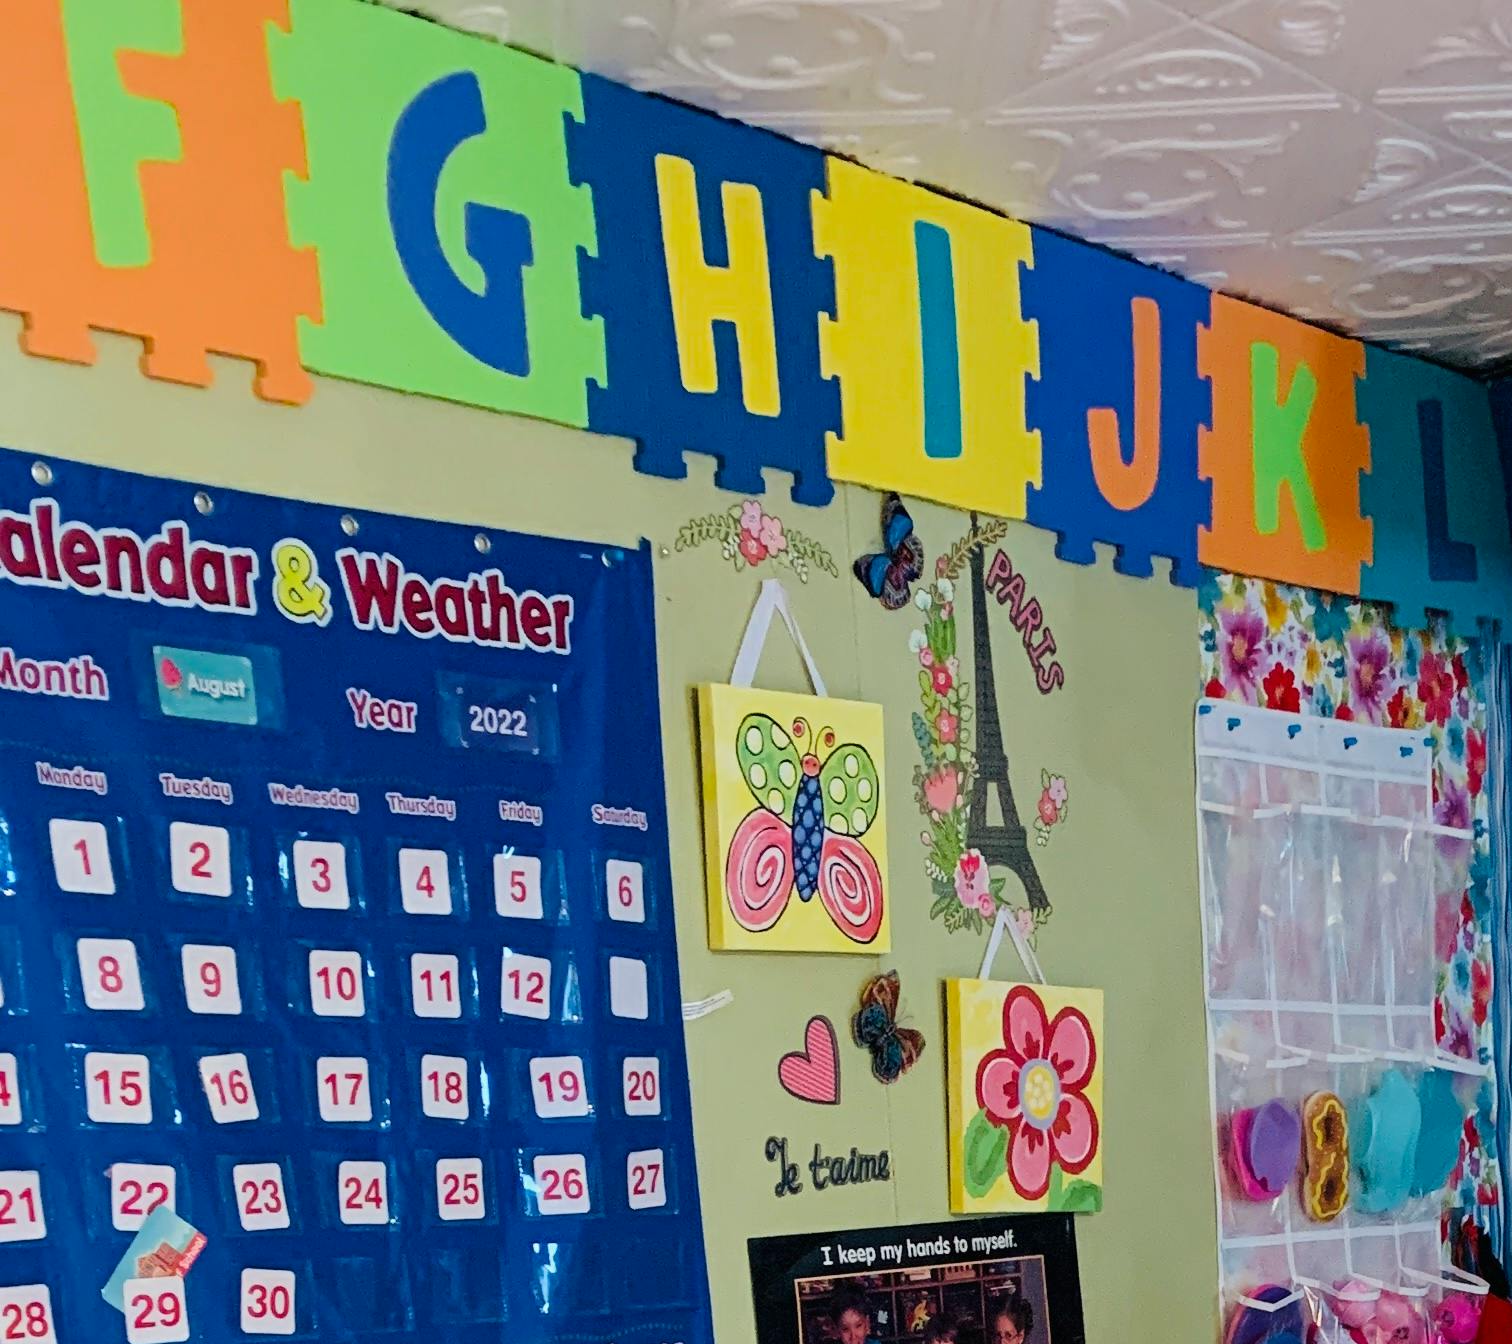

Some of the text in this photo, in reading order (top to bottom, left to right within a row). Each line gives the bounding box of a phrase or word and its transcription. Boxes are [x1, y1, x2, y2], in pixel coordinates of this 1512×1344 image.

[62, 0, 184, 268] F
[386, 70, 533, 377] G
[655, 154, 781, 416] H
[914, 219, 962, 458] I
[1088, 297, 1161, 511] J
[1250, 341, 1326, 552] K
[1417, 399, 1478, 582] L
[0, 497, 572, 652] alendar & Weather
[984, 549, 1065, 696] PARIS
[187, 672, 248, 701] August
[346, 688, 417, 733] Year
[469, 704, 528, 738] 2022
[37, 761, 648, 831] Monday Tuesday Wednesday Thursday Friday Saturday
[74, 839, 633, 907] 1 2 3 4 5 6
[98, 956, 545, 1004] 8 9 10 11 12
[93, 1069, 655, 1107] 15 16 17 18 19 20
[242, 1178, 282, 1214] 23
[344, 1177, 383, 1209] 24
[443, 1173, 479, 1204] 25
[541, 1169, 582, 1200] 26
[632, 1163, 661, 1194] 27
[764, 1135, 802, 1198] Je
[820, 1230, 1018, 1267] I keep my hands to myself.
[3, 1285, 290, 1339] 28 29 30
